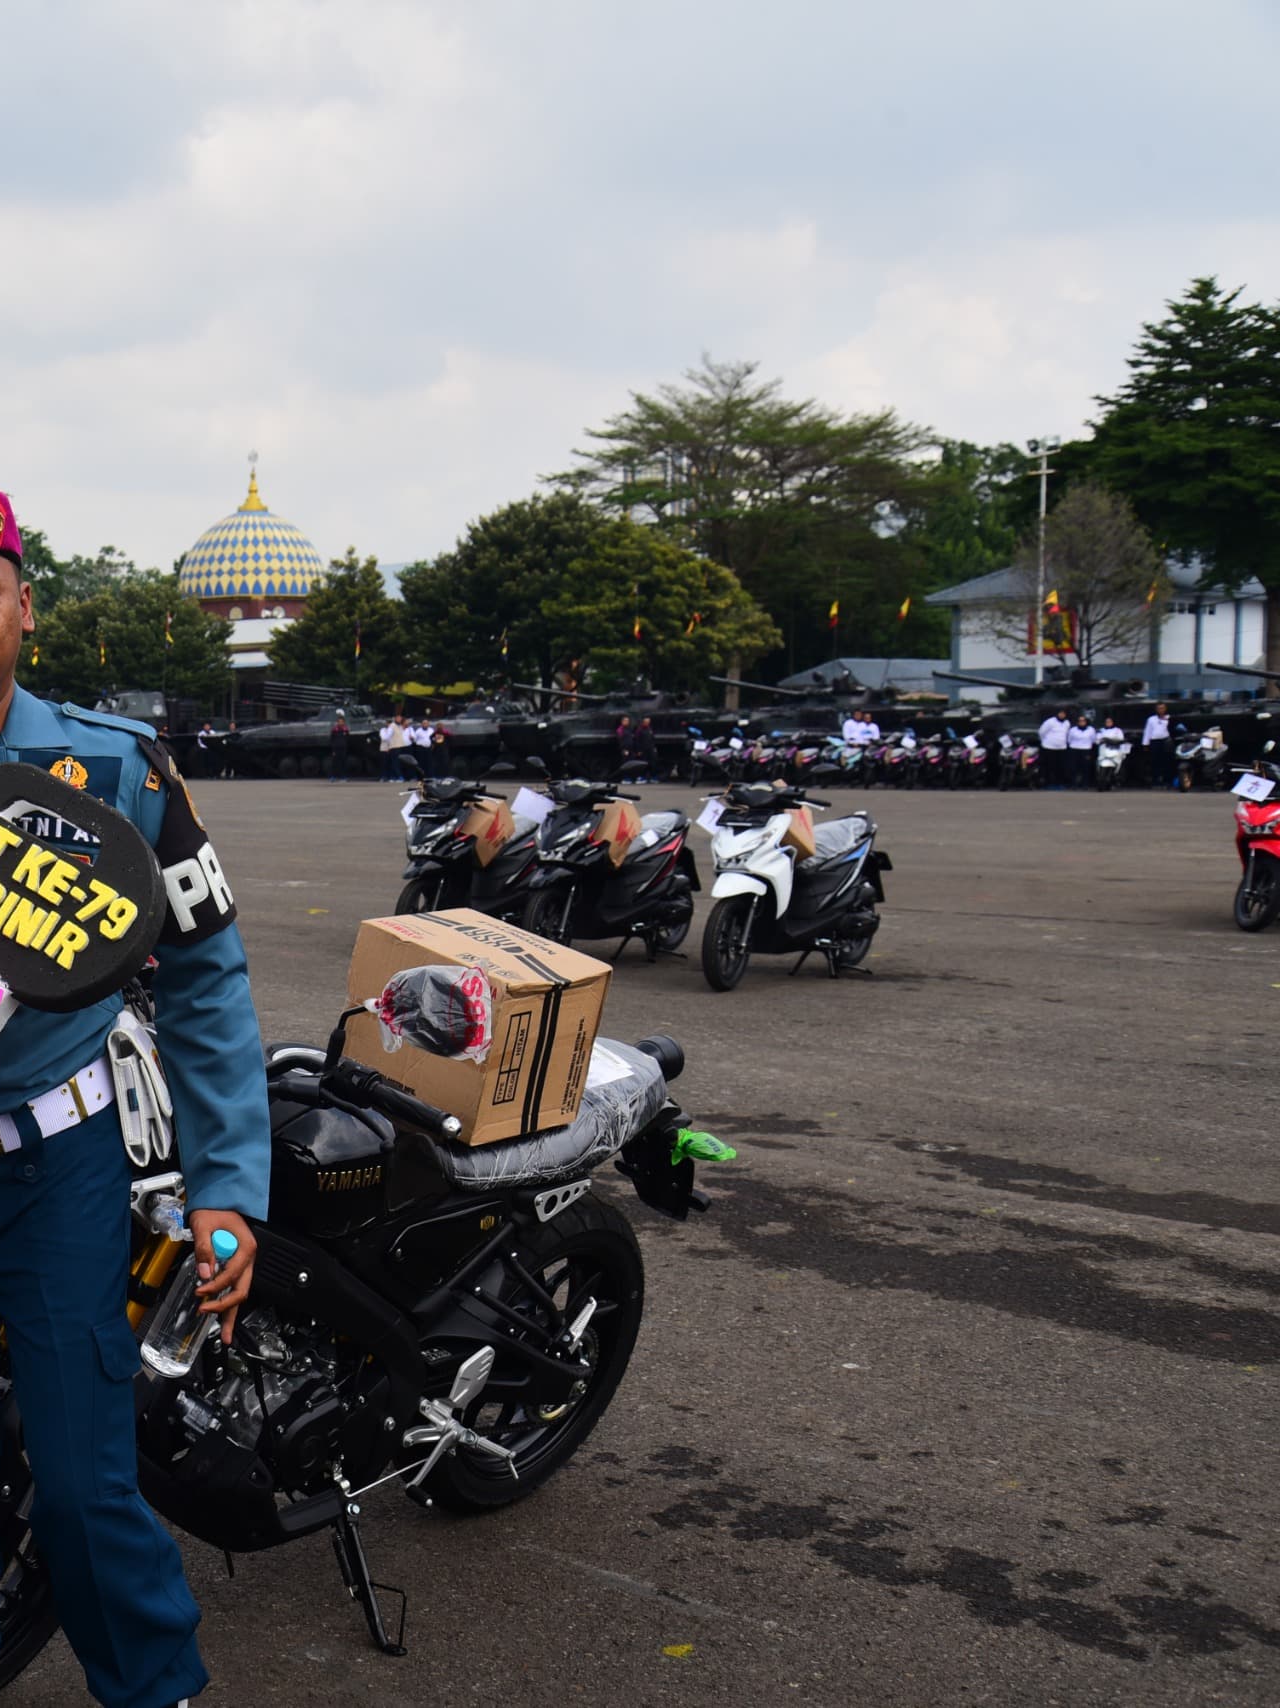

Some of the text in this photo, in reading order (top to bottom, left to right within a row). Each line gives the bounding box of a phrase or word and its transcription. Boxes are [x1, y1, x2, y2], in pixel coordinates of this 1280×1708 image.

[20, 816, 62, 838] TNI
[12, 844, 138, 941] KE-79
[317, 1165, 382, 1191] YAMAHA
